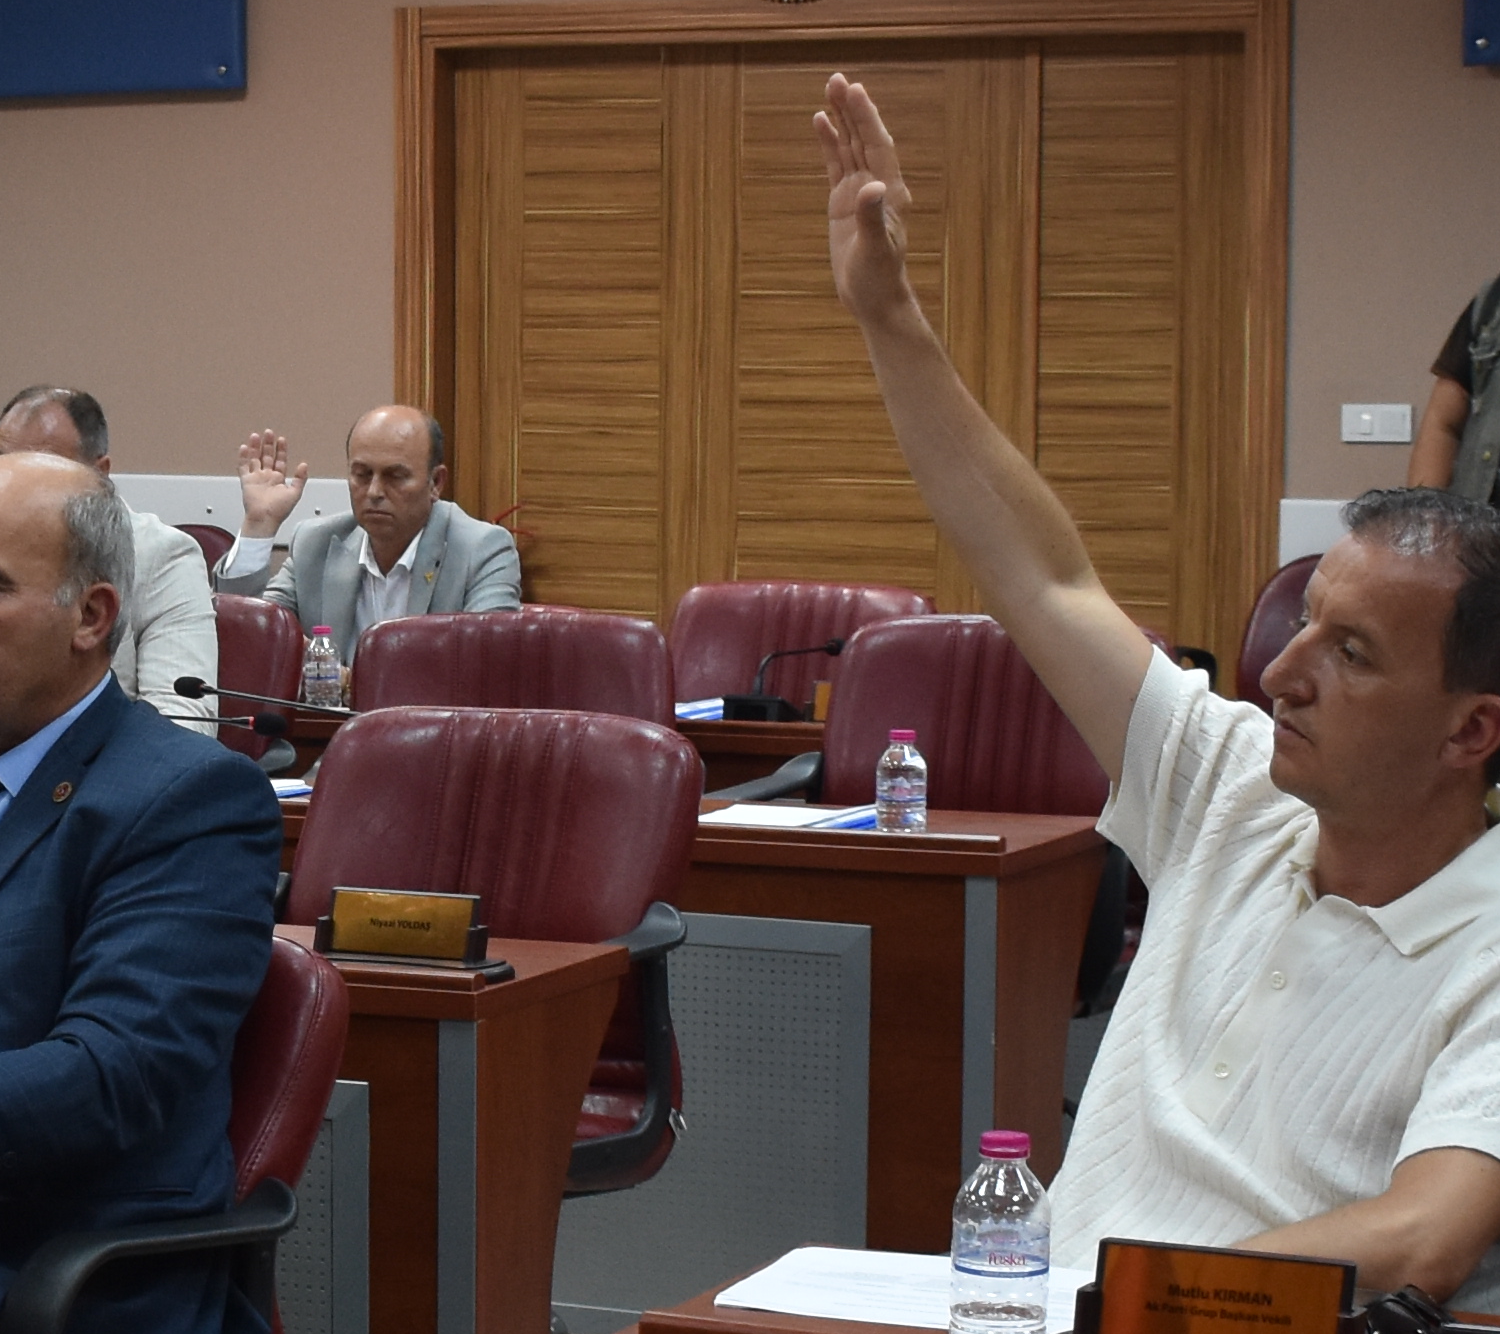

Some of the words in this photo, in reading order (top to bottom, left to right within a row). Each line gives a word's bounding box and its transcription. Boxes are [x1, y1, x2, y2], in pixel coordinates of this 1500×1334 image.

[370, 917, 395, 928] Niyazi
[397, 920, 431, 933] YOLDAŞ
[1167, 1283, 1209, 1299] Mutlu
[1212, 1288, 1273, 1306] KIRMAN
[1189, 1306, 1217, 1320] Grup
